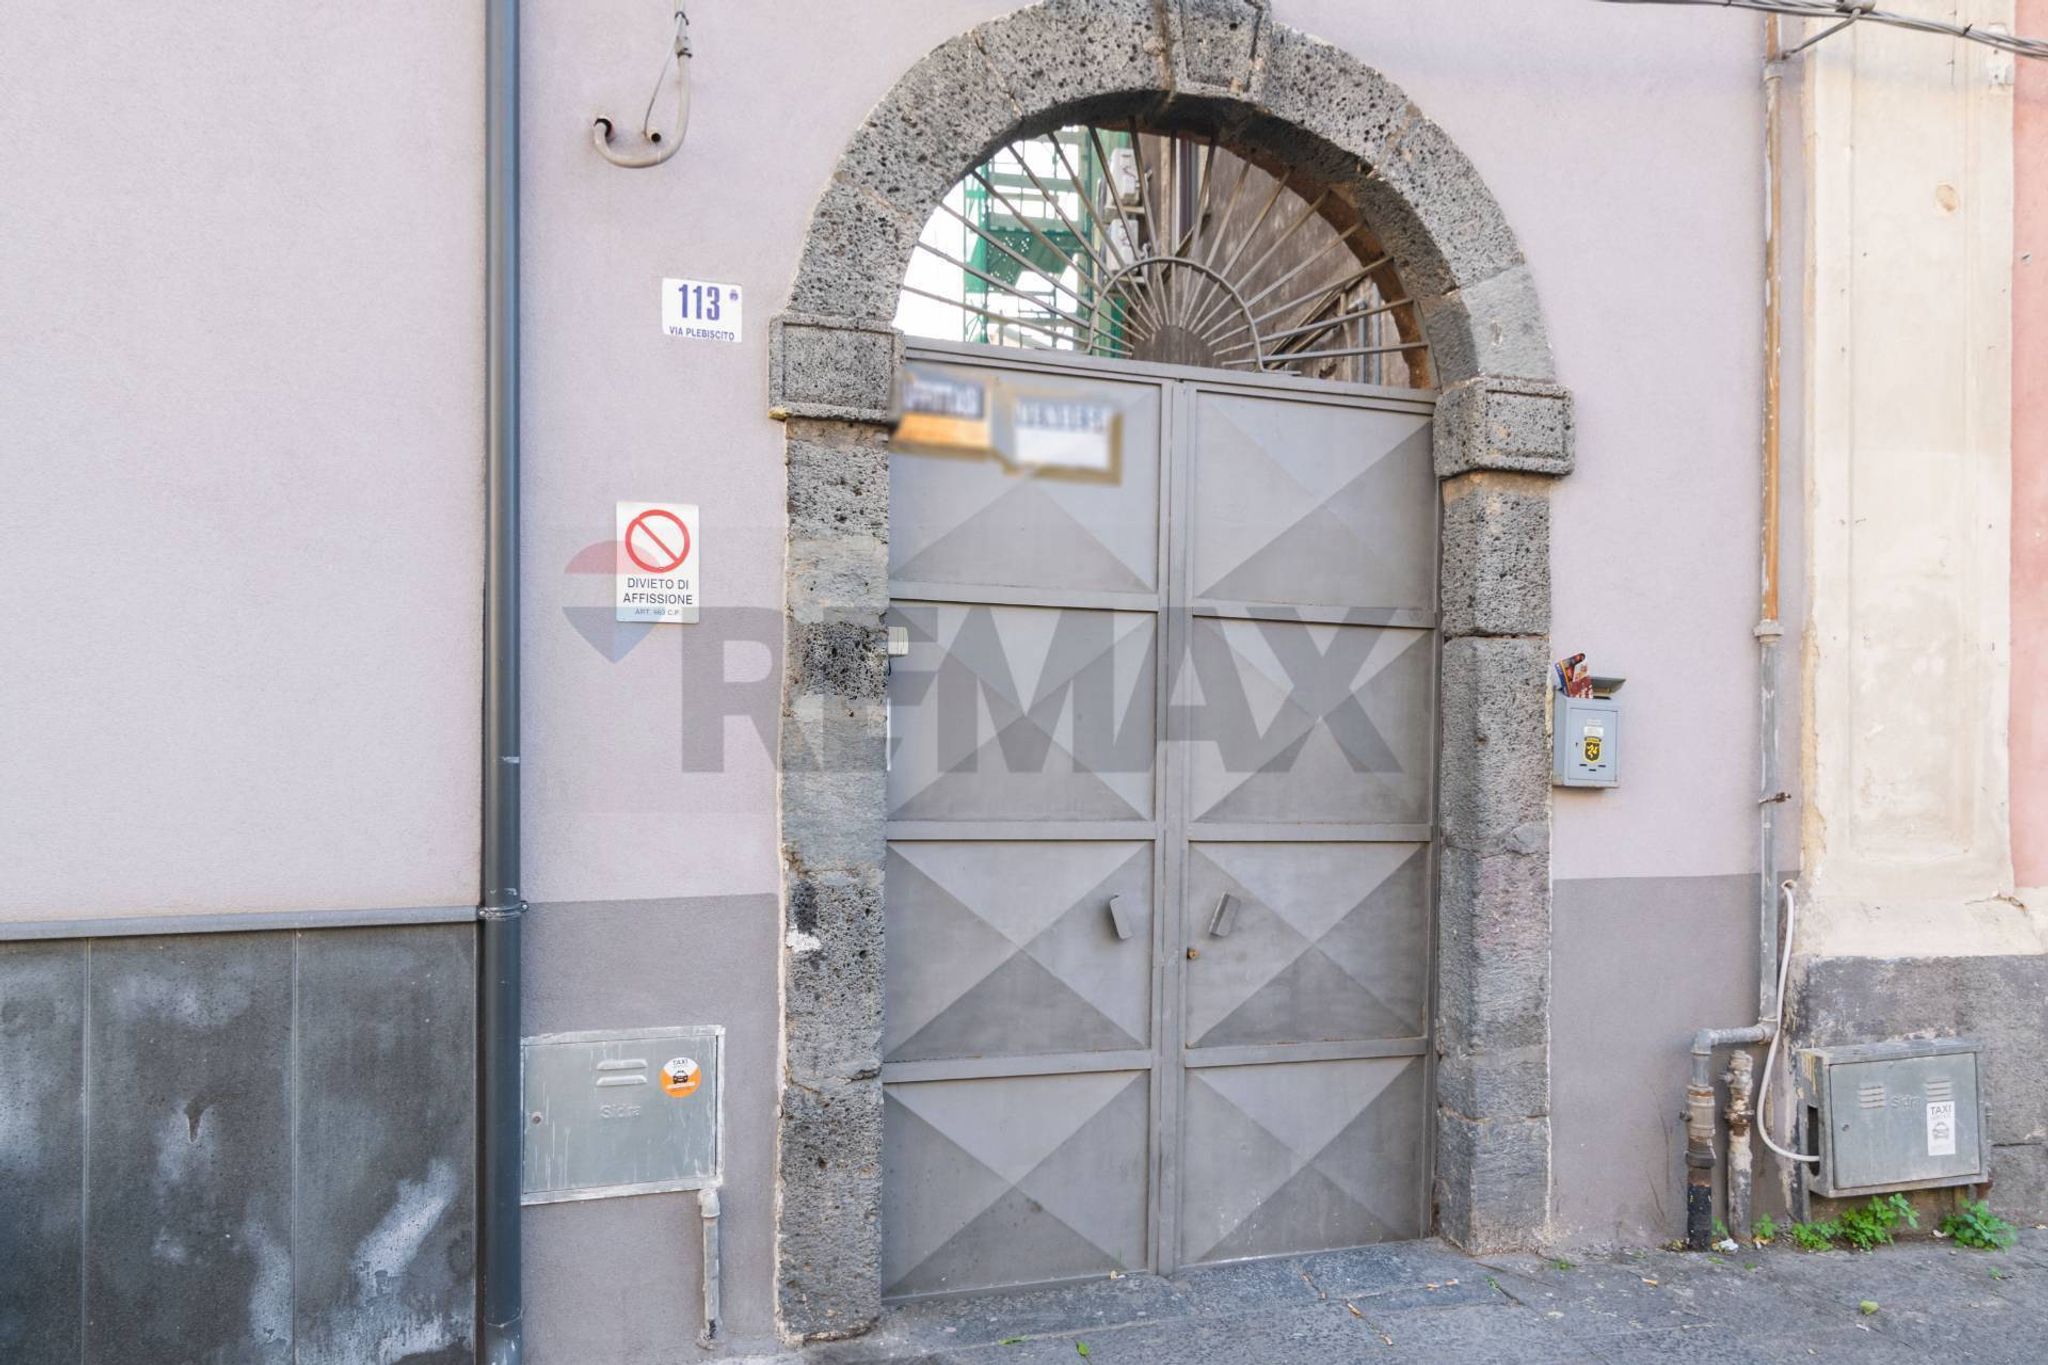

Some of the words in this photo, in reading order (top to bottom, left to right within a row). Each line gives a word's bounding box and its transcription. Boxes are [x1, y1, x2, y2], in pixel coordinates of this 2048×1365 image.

[678, 283, 720, 321] 113
[669, 326, 684, 336] VIA
[686, 327, 735, 341] PLEBISCITO
[627, 577, 675, 590] DIVIETO
[678, 579, 689, 590] DI
[622, 593, 693, 605] AFFISSIONE
[1930, 1103, 1952, 1115] TAXI
